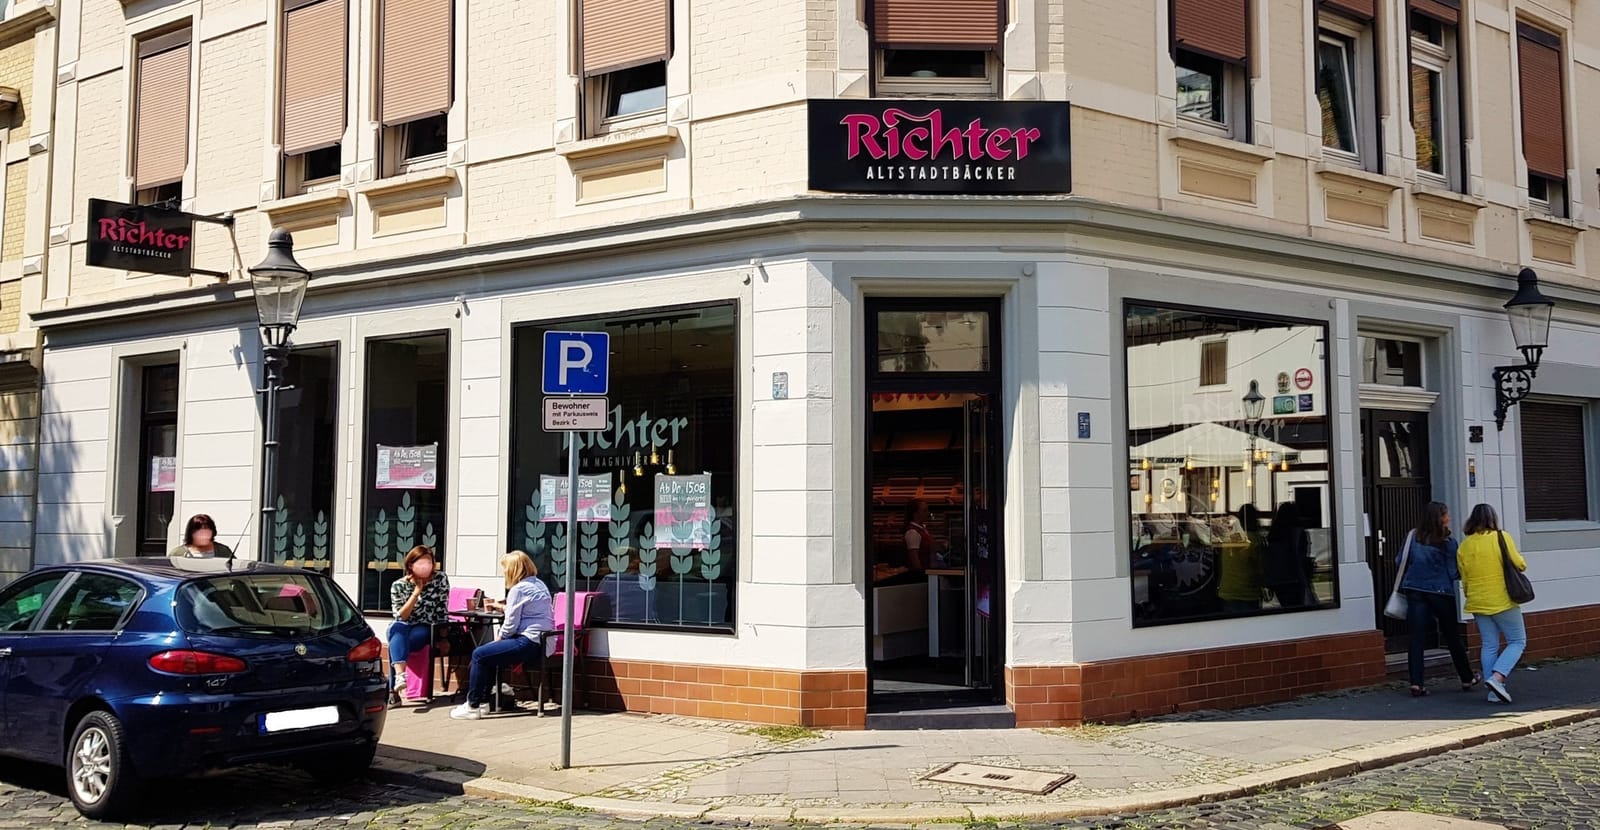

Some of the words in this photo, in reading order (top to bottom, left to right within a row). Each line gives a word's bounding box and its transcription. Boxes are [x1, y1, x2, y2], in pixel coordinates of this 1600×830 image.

[839, 107, 1041, 161] Richter
[866, 164, 1016, 181] ALTSTADTBÄCKER
[98, 217, 189, 249] Richter
[558, 340, 593, 386] P
[552, 402, 591, 410] Bewohner
[562, 403, 689, 451] ichter
[571, 418, 578, 426] C
[594, 454, 667, 467] MAGNIVIEREL
[659, 481, 670, 494] Ab
[205, 676, 227, 687] 147
